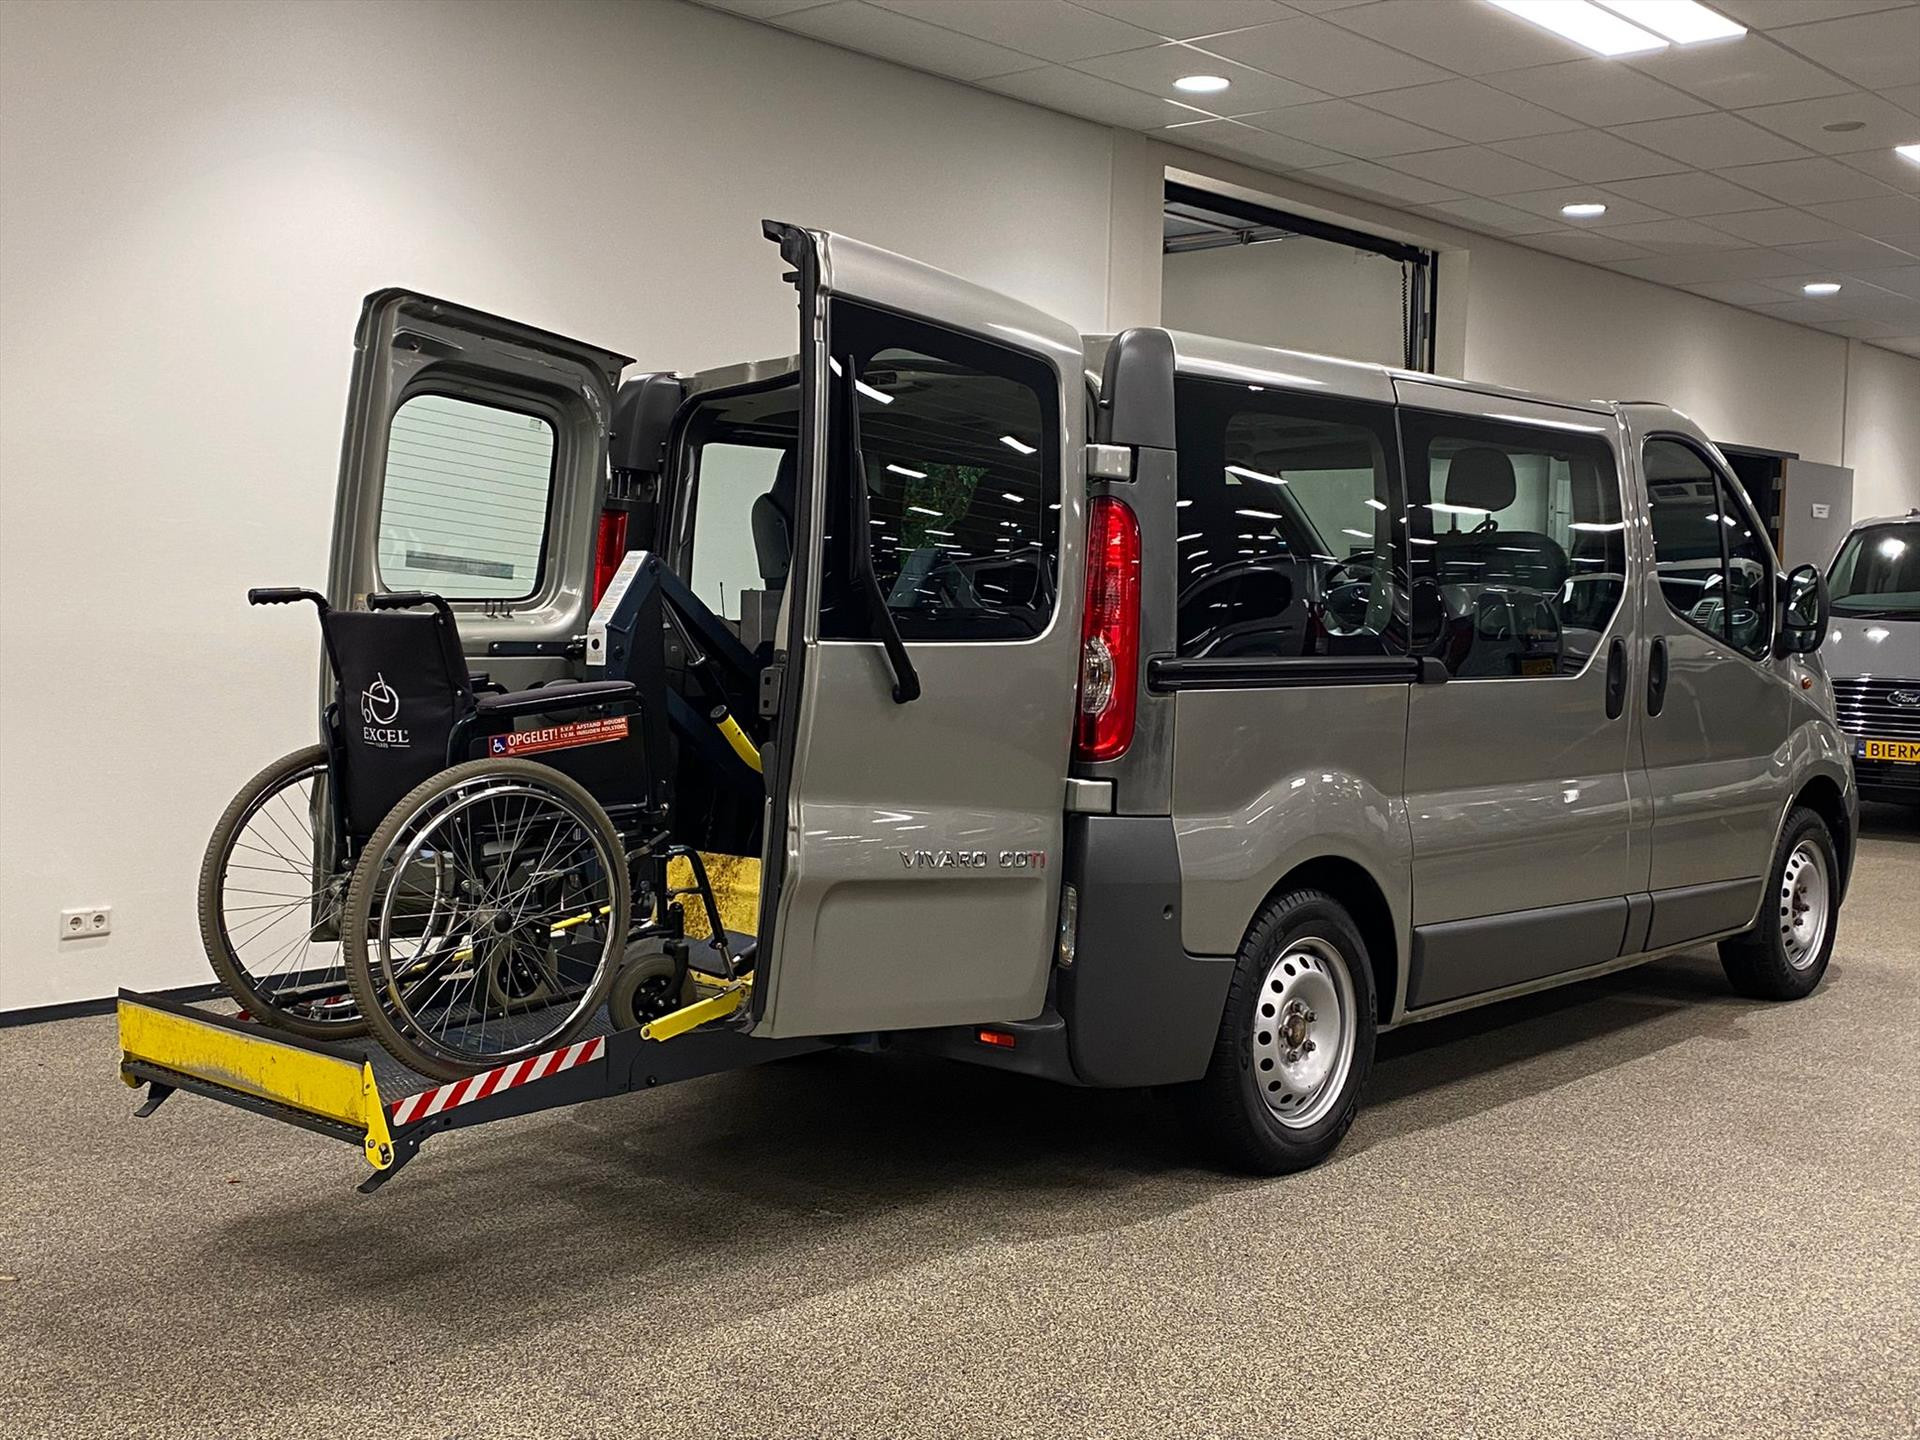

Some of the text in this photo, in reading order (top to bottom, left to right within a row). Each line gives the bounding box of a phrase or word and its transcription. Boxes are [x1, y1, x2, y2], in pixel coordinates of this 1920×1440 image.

[363, 726, 410, 743] EXCEL
[507, 728, 558, 746] OPGELET!
[899, 850, 988, 868] VIVARO
